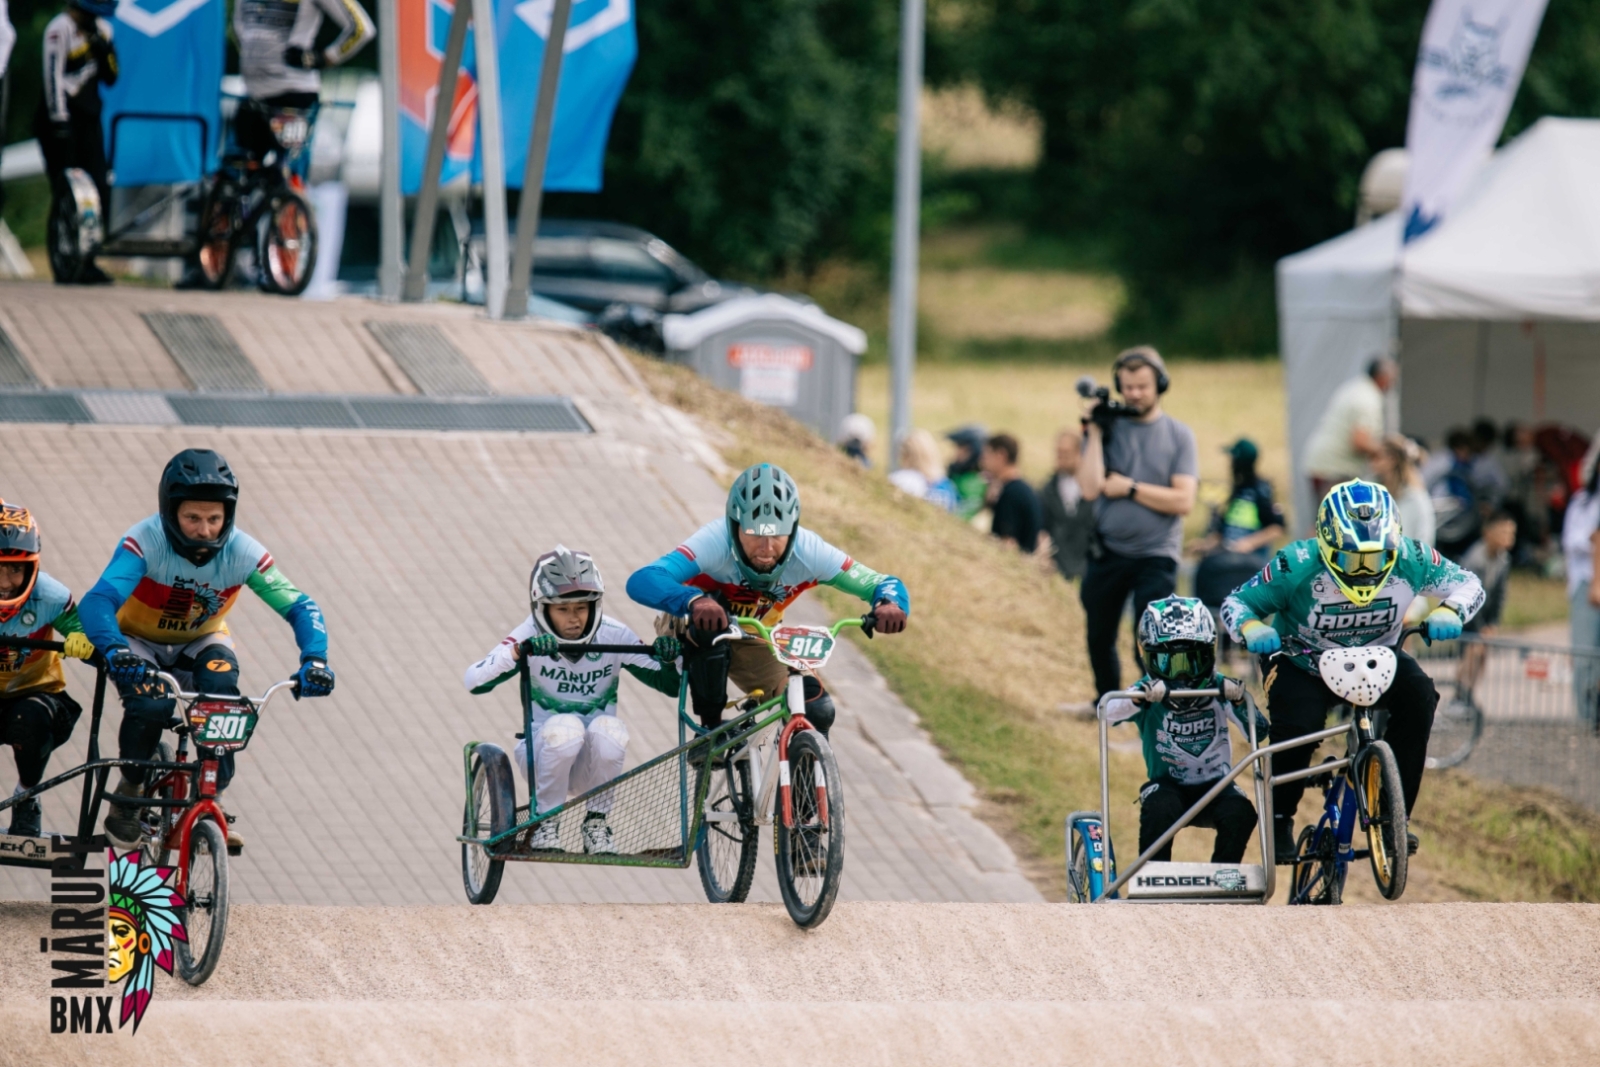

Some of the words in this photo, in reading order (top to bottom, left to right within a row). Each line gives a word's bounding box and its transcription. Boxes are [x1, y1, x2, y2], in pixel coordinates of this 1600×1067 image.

[158, 618, 188, 631] BMX
[1316, 606, 1396, 630] ADAZI
[790, 636, 824, 657] 914
[539, 664, 613, 684] MĀRUPE
[556, 682, 597, 696] BMX
[206, 715, 248, 739] 901
[1168, 718, 1215, 735] ADAZ
[1137, 876, 1247, 887] HEDGEHG
